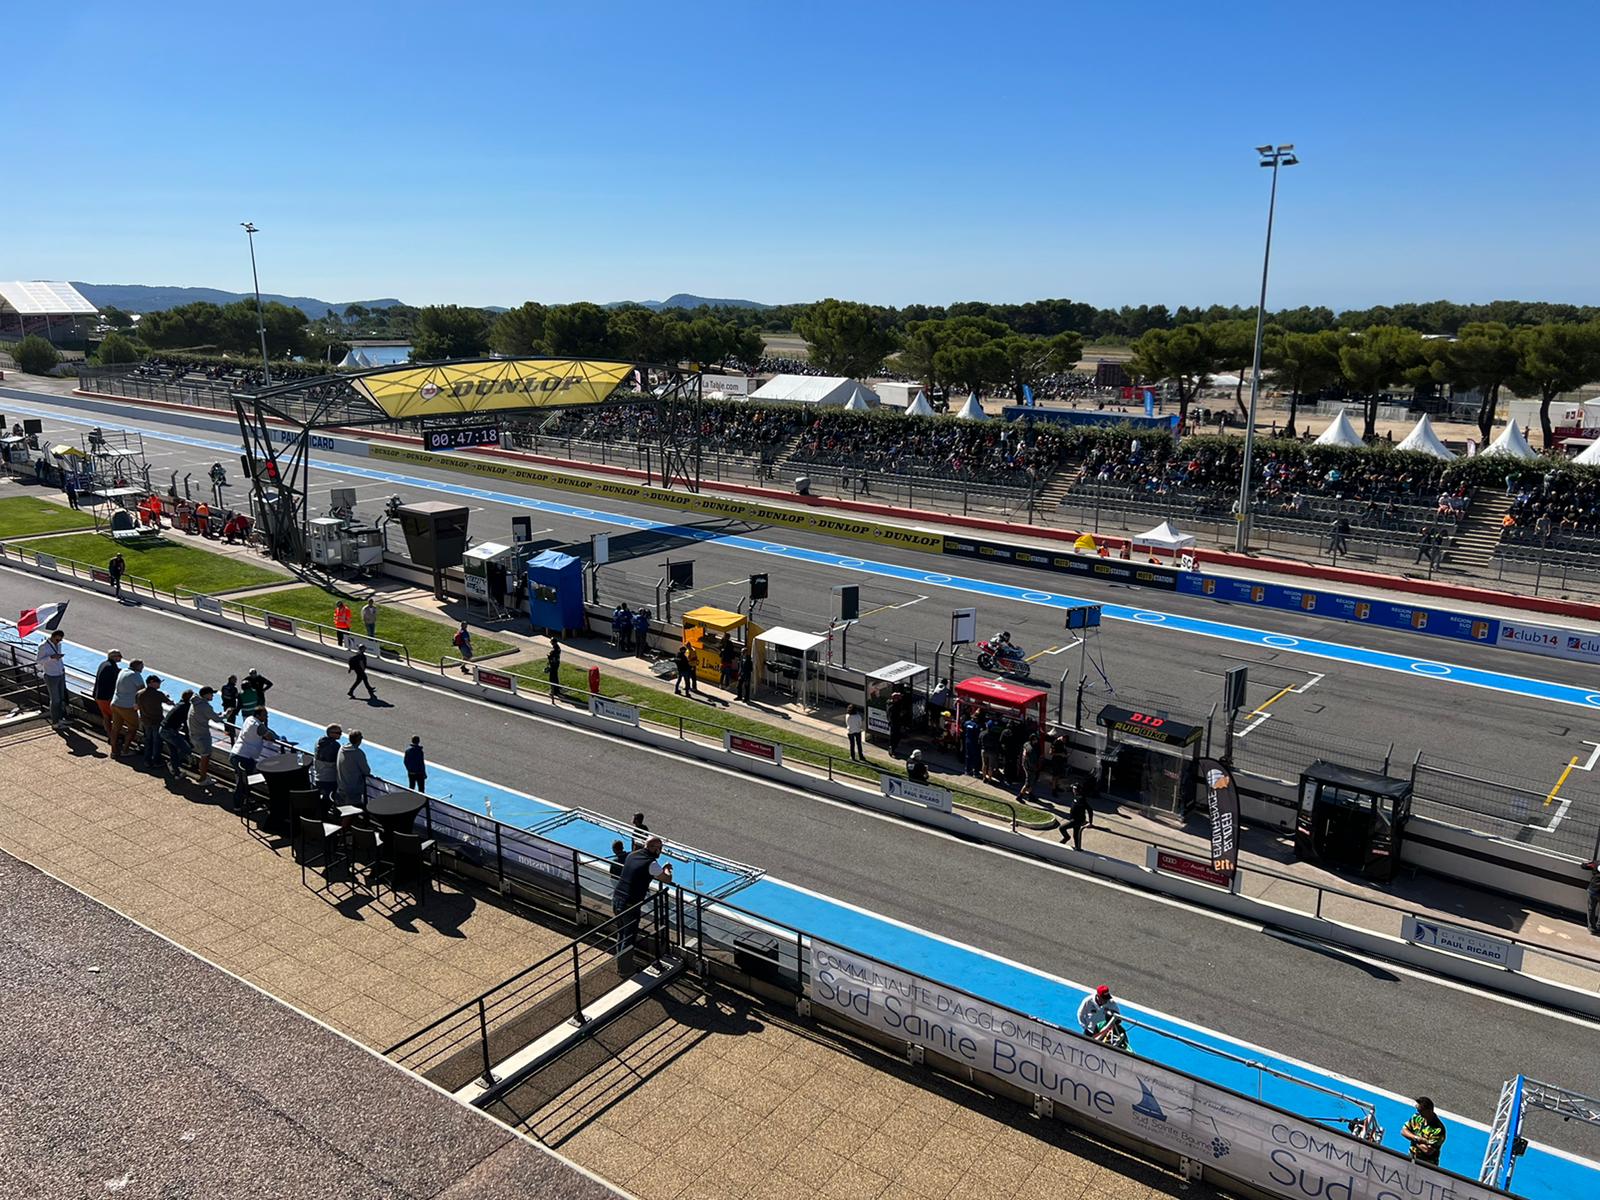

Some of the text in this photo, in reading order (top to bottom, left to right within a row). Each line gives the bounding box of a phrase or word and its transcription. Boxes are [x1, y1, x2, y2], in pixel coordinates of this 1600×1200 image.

[446, 375, 583, 398] DUNLOP
[305, 435, 335, 450] ICARD
[431, 429, 497, 447] 00:47:18
[440, 458, 469, 468] DUNLOP
[477, 464, 507, 475] DUNLOP
[515, 471, 548, 482] DUNLOP
[557, 477, 593, 489] DUNLOP
[602, 485, 640, 497] DUNLOP
[650, 493, 690, 505] DUNLOP
[702, 500, 746, 514] DUNLOP
[757, 510, 805, 525] DUNLOP
[818, 519, 870, 535] DUNLOP
[883, 530, 941, 547] DUNLOP
[1182, 557, 1192, 570] SC
[1514, 630, 1558, 646] club14
[1130, 712, 1165, 727] DID
[1441, 931, 1501, 951] CIRCUIT
[1440, 938, 1502, 960] PAUL RICARD
[816, 949, 1118, 1078] COMMUNAUTE D'AGGLOMERATION
[817, 970, 1116, 1115] Sud Sainte Baume
[1132, 1111, 1149, 1125] Sud
[1151, 1118, 1178, 1136] Sainte
[1181, 1129, 1213, 1150] Baume
